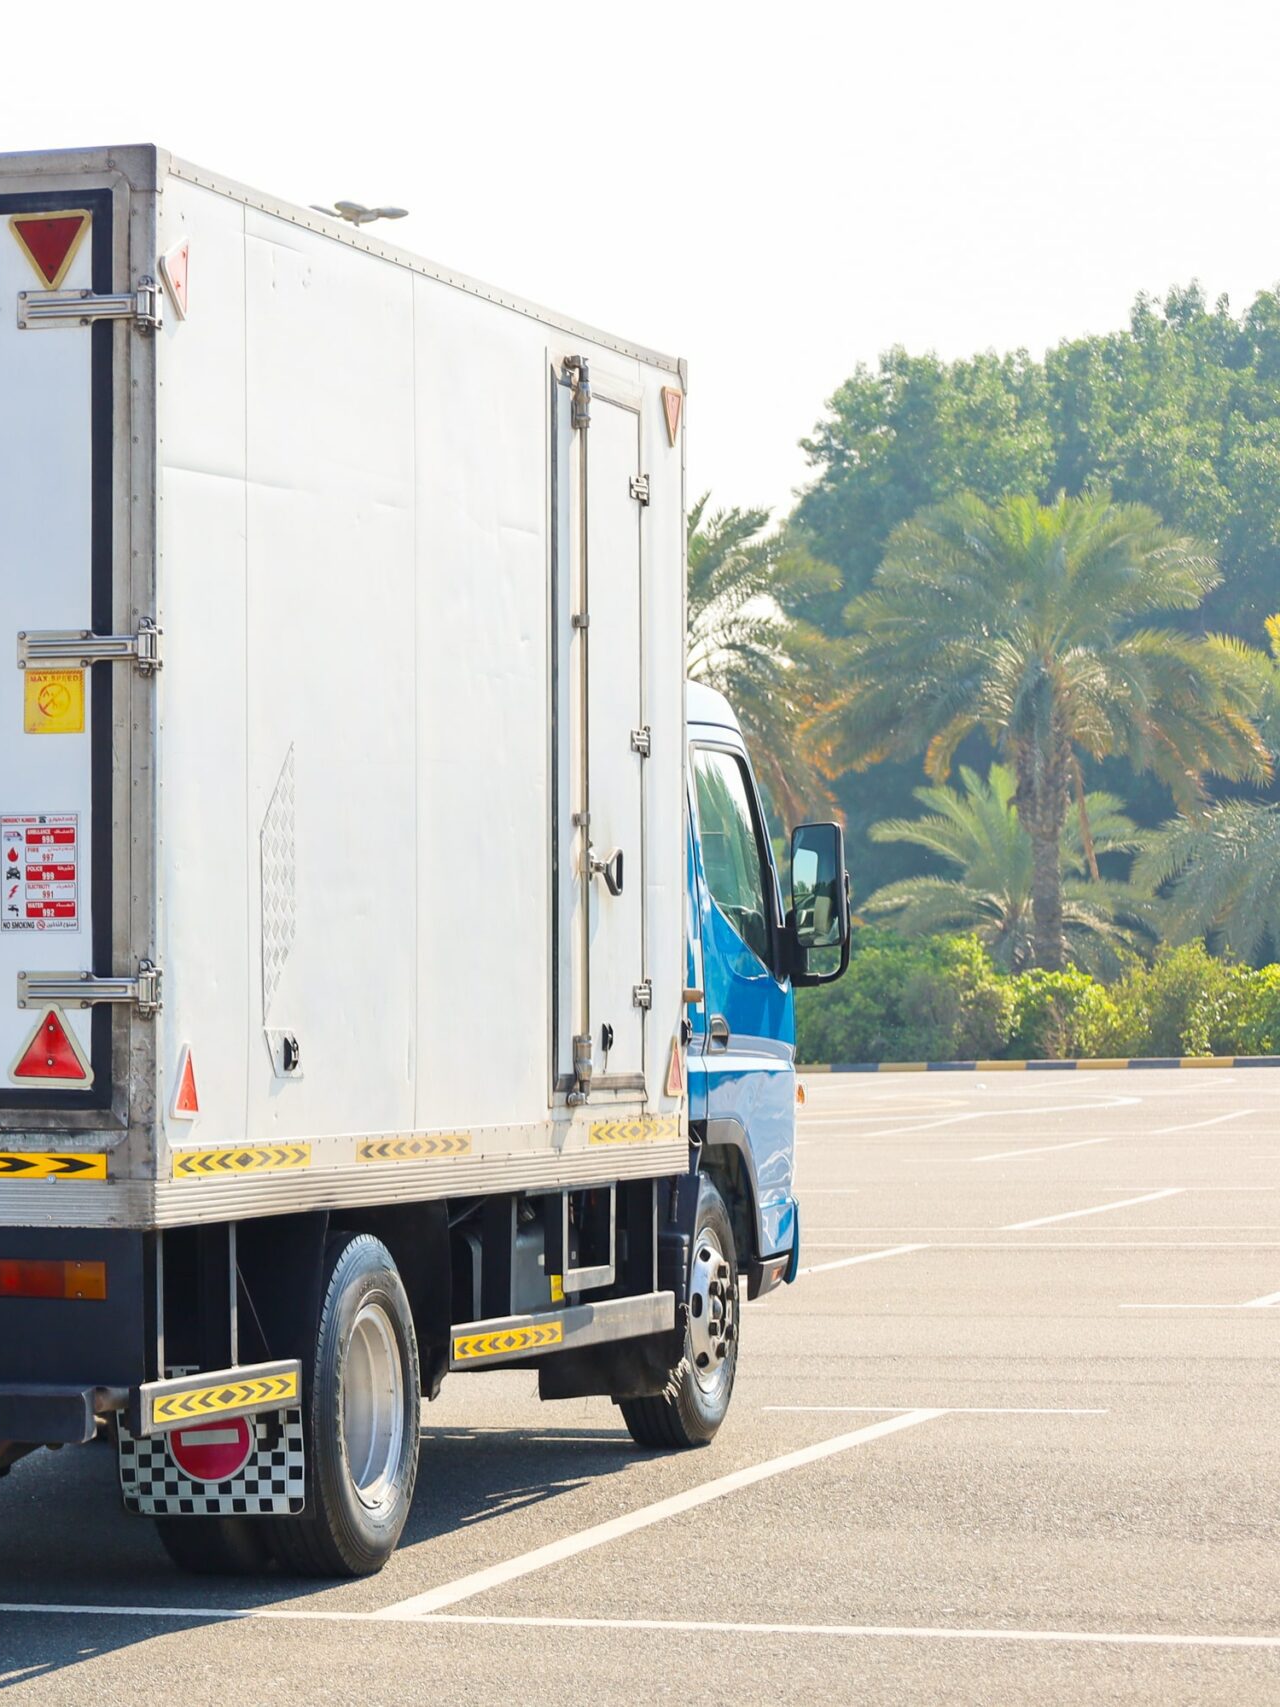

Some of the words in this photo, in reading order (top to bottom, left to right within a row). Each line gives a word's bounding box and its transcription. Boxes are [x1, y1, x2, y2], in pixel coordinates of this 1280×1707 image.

[42, 853, 54, 861] 997
[42, 890, 54, 899] 991
[42, 908, 55, 917] 992
